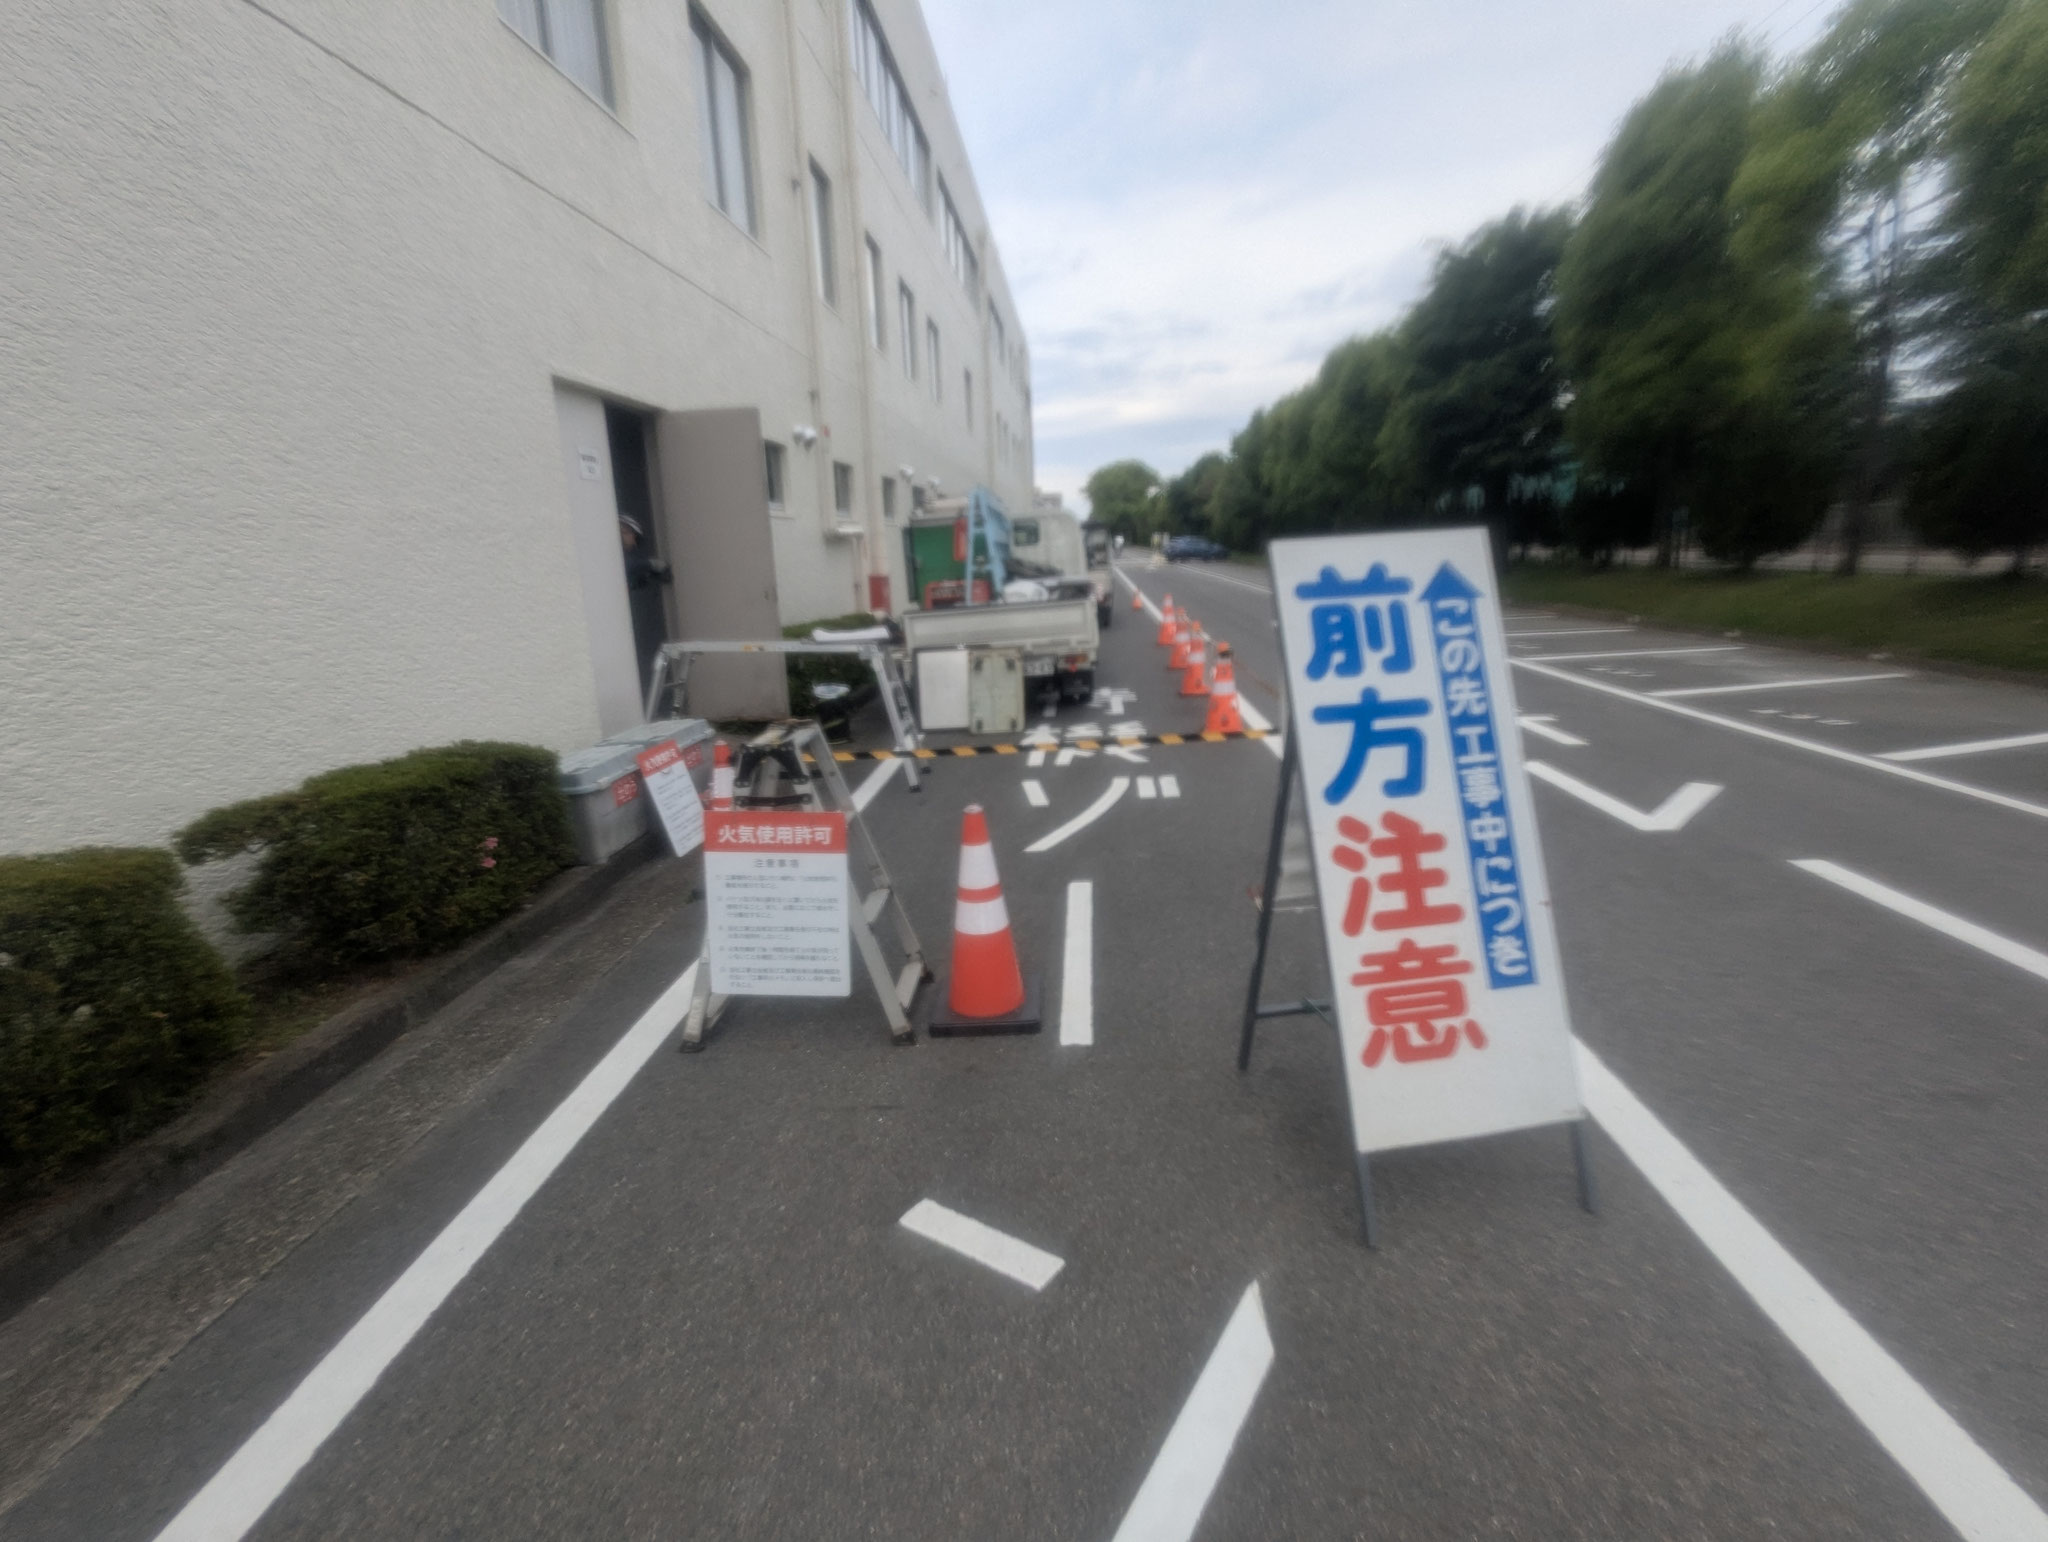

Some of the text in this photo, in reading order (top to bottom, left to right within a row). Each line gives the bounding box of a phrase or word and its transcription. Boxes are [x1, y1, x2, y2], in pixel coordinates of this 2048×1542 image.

[717, 824, 833, 846] 火気使用許可
[1294, 562, 1489, 1069] 前方注意
[1436, 598, 1530, 977] この先工事中につき
